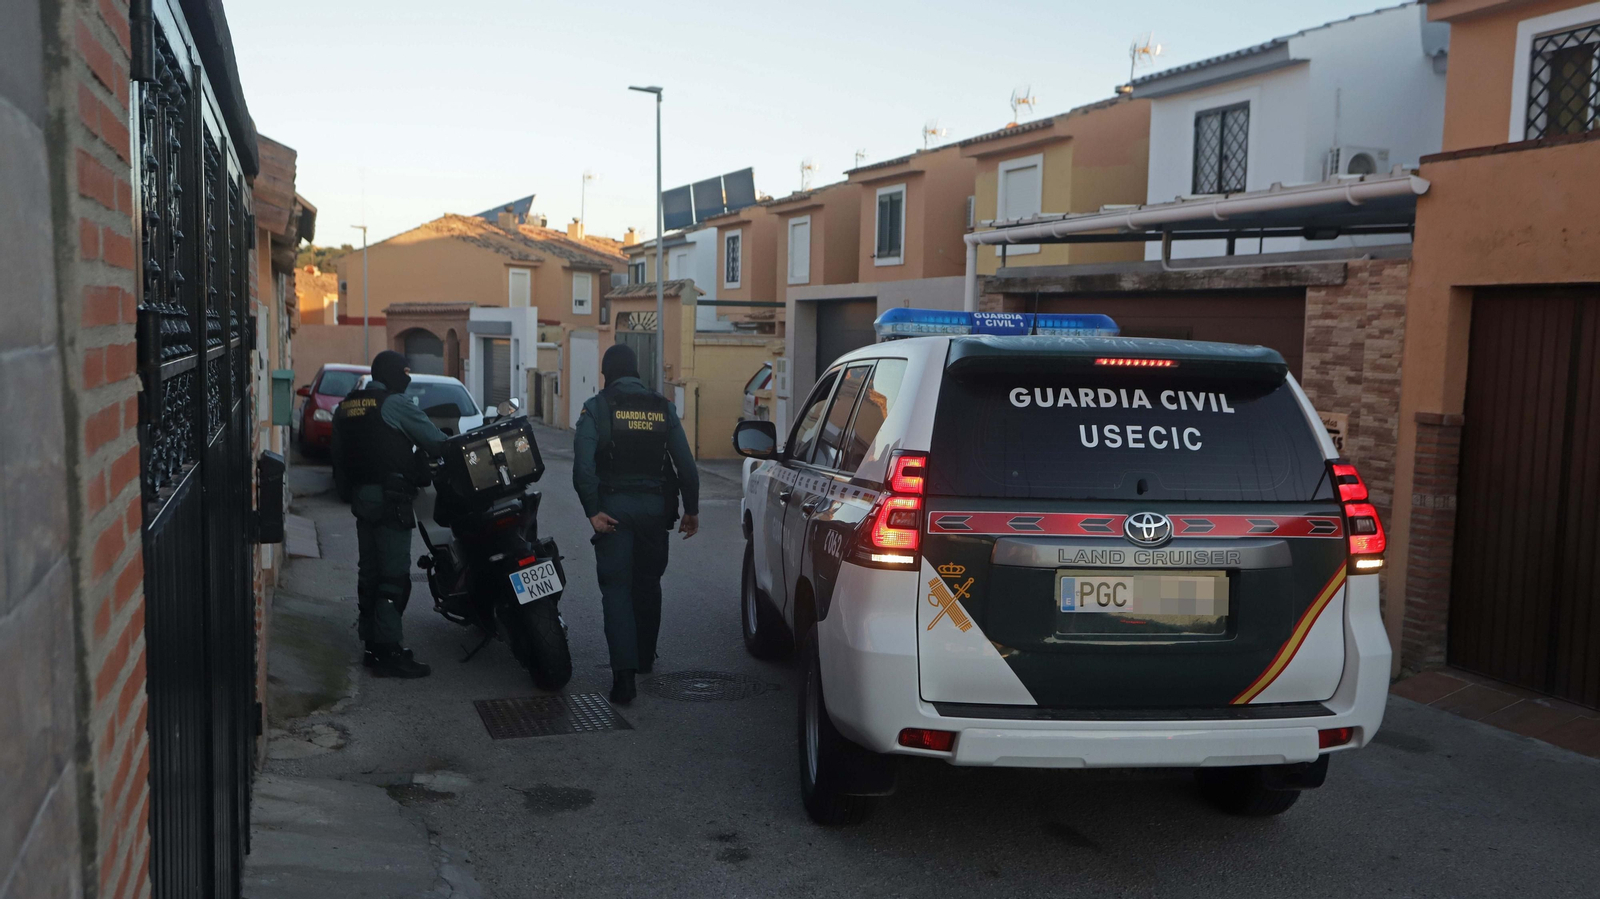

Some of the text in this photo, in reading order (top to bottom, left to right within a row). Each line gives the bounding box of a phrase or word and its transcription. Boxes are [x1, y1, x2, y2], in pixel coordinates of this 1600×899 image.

[973, 312, 1023, 320] GUARDIA
[985, 319, 1016, 328] CIVIL
[361, 398, 377, 407] CIVIL
[1009, 387, 1235, 414] GUARDIA CIVIL
[615, 410, 665, 422] GUARDIA CIVIL
[628, 420, 653, 430] USECIC
[1079, 424, 1203, 451] USECIC
[1057, 549, 1242, 566] LAND CRUISER
[521, 563, 555, 584] 8820
[527, 579, 554, 599] KNN
[1079, 581, 1127, 608] PGC
[1065, 597, 1072, 605] E
